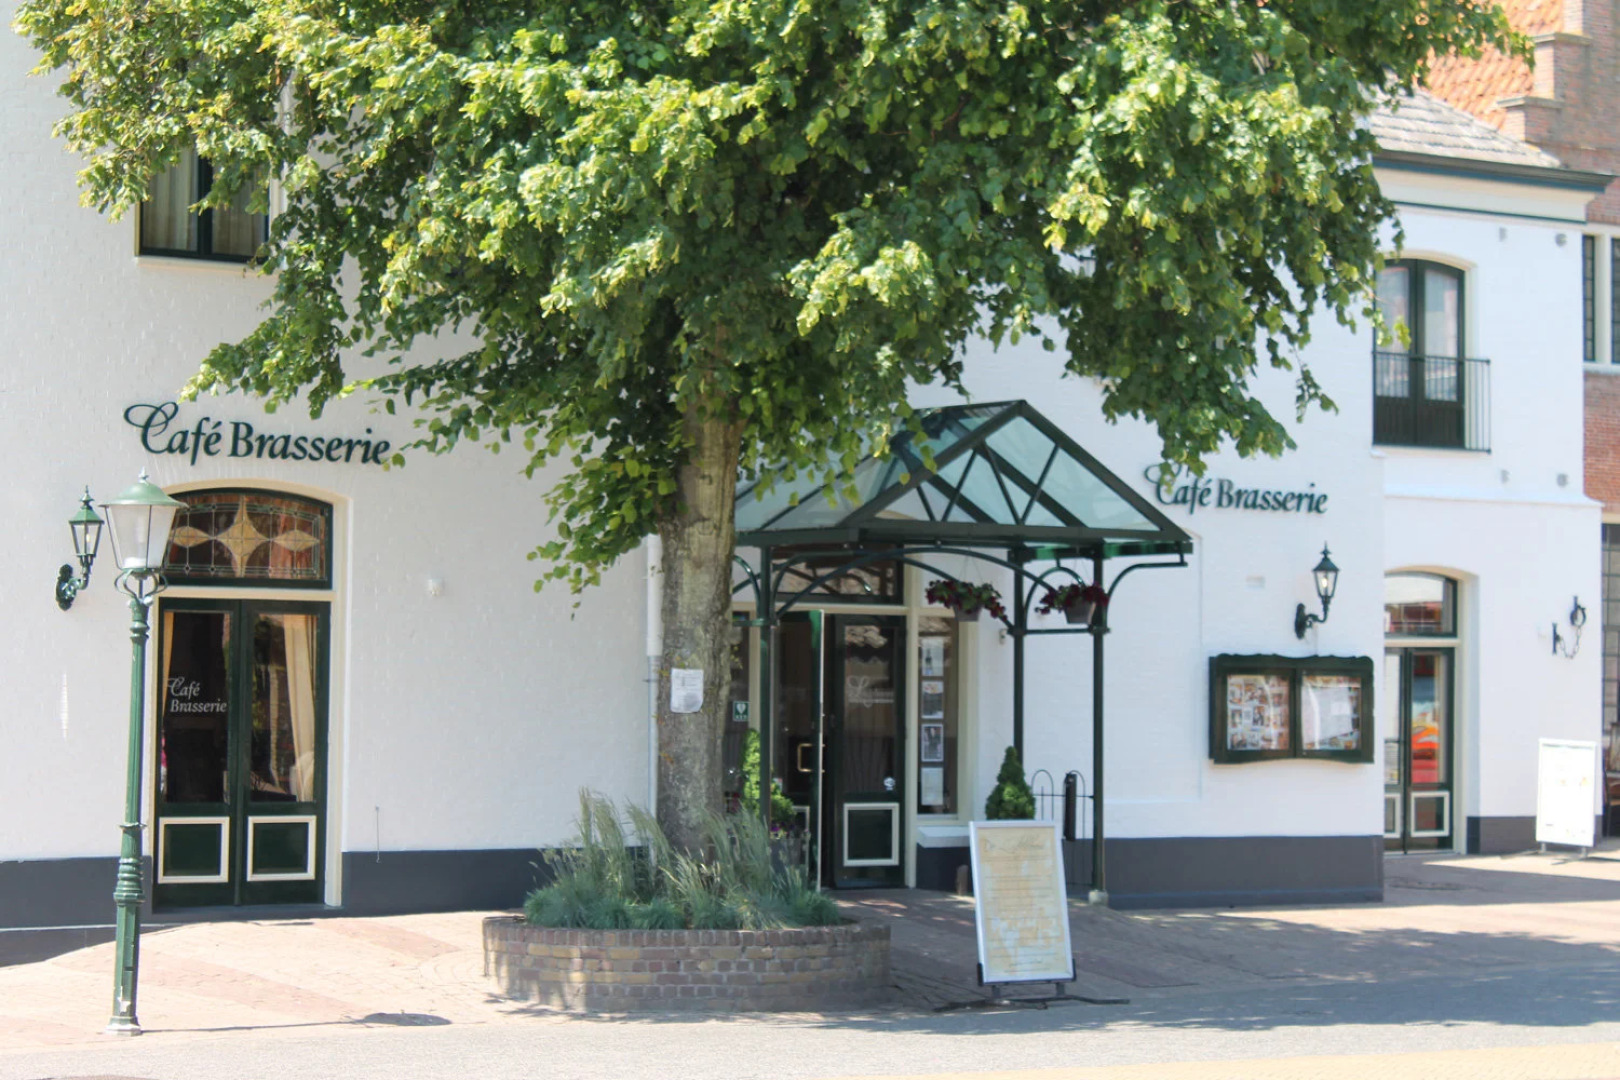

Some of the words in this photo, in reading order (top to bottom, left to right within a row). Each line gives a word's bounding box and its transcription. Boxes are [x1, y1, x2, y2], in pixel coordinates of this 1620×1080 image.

[123, 401, 223, 466] Café
[228, 421, 391, 465] Brasserie
[1143, 463, 1212, 515] Café
[1216, 478, 1328, 514] Brasserie
[166, 676, 200, 700] Café
[170, 698, 227, 713] Brasserie
